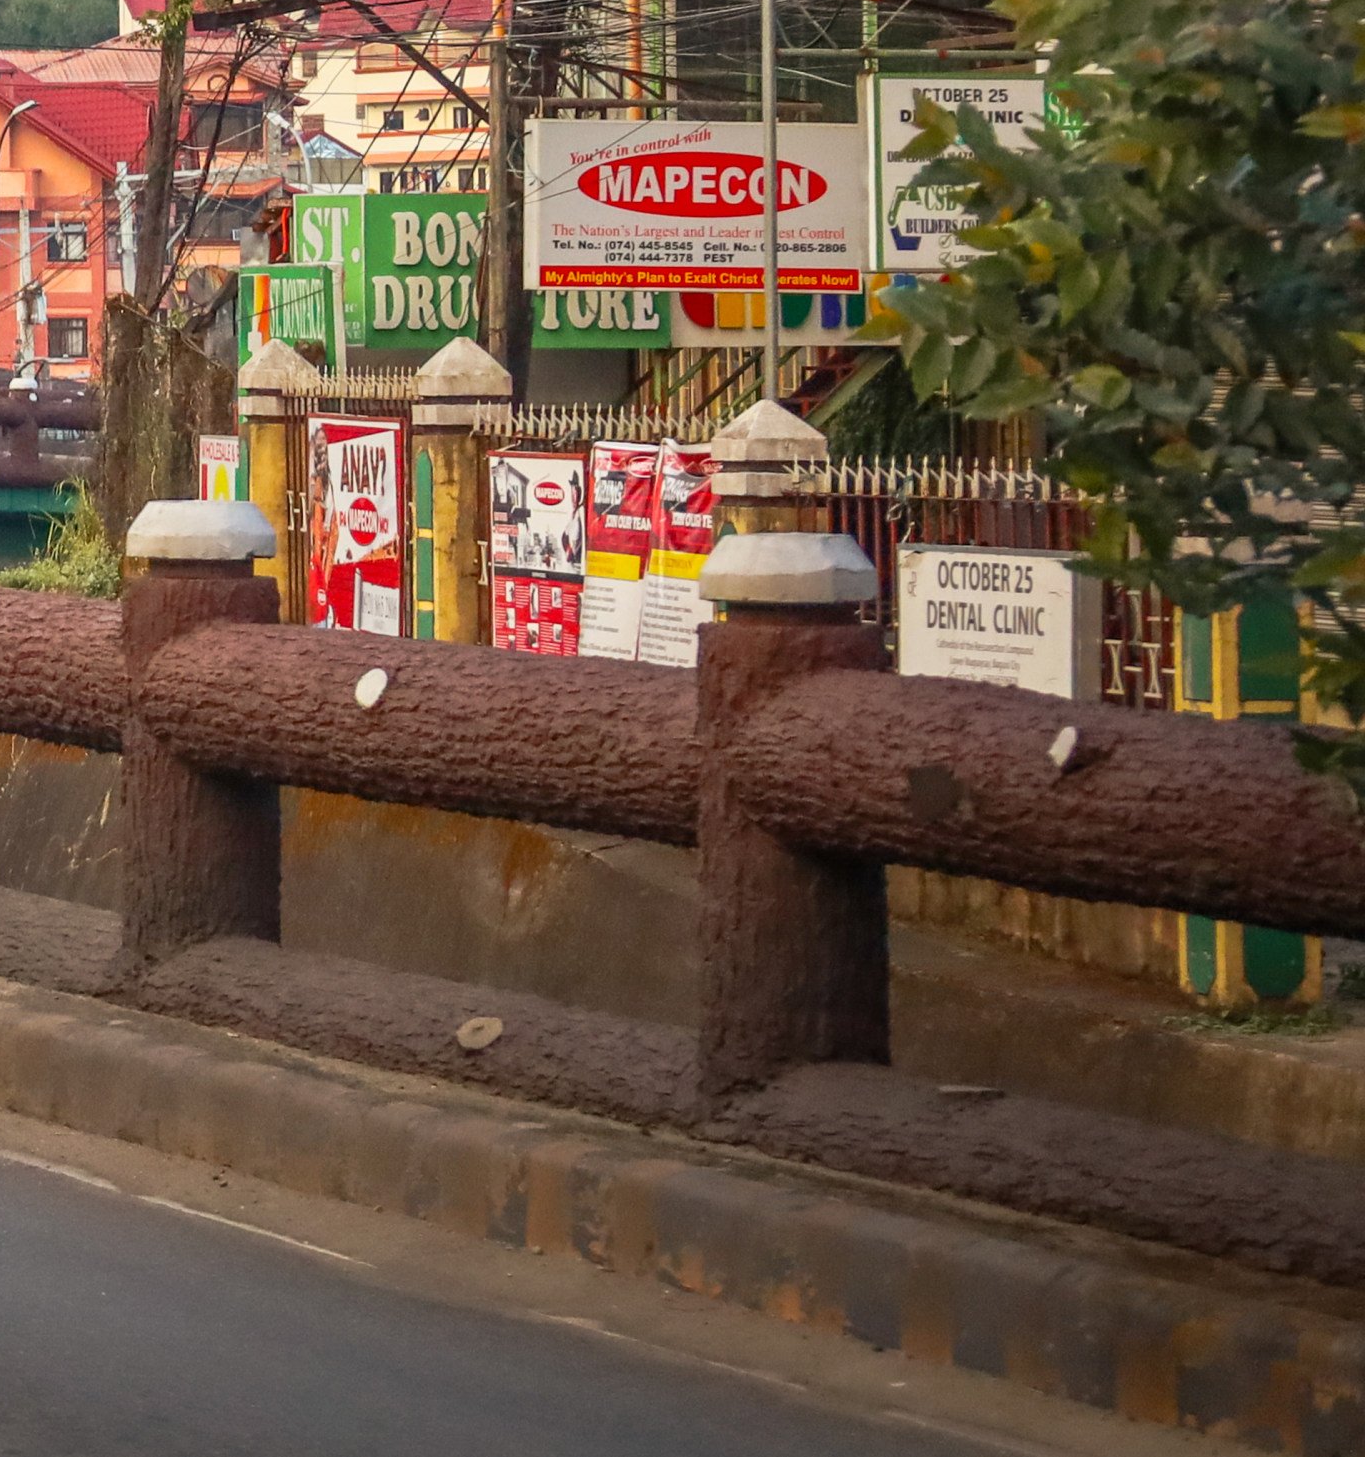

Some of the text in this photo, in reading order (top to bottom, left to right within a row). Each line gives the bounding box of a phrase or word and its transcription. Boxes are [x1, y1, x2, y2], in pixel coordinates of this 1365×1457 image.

[989, 89, 1008, 103] 25
[569, 129, 711, 166] You're in control with
[302, 206, 362, 264] ST.
[551, 223, 575, 236] The
[579, 224, 631, 236] Nation's
[634, 225, 679, 240] Largest
[683, 226, 705, 237] and
[709, 226, 751, 238] Leader
[779, 228, 795, 239] est
[799, 227, 845, 239] Control
[552, 240, 574, 250] Tel.
[604, 241, 635, 252] (074)
[638, 241, 693, 251] 445-8545
[703, 242, 730, 252] Cell.
[604, 252, 735, 263] (074) 444-7378 PEST
[545, 271, 563, 285] My
[566, 271, 633, 285] Almighty's
[637, 272, 665, 284] Plan
[669, 272, 681, 283] to
[685, 272, 716, 284] Exalt
[720, 272, 758, 284] Christ
[821, 274, 853, 286] Now!
[340, 443, 387, 497] ANAY?
[937, 559, 1010, 593] OCTOBER
[1014, 565, 1033, 594] 25
[926, 599, 1045, 637] DENTAL CLINIC
